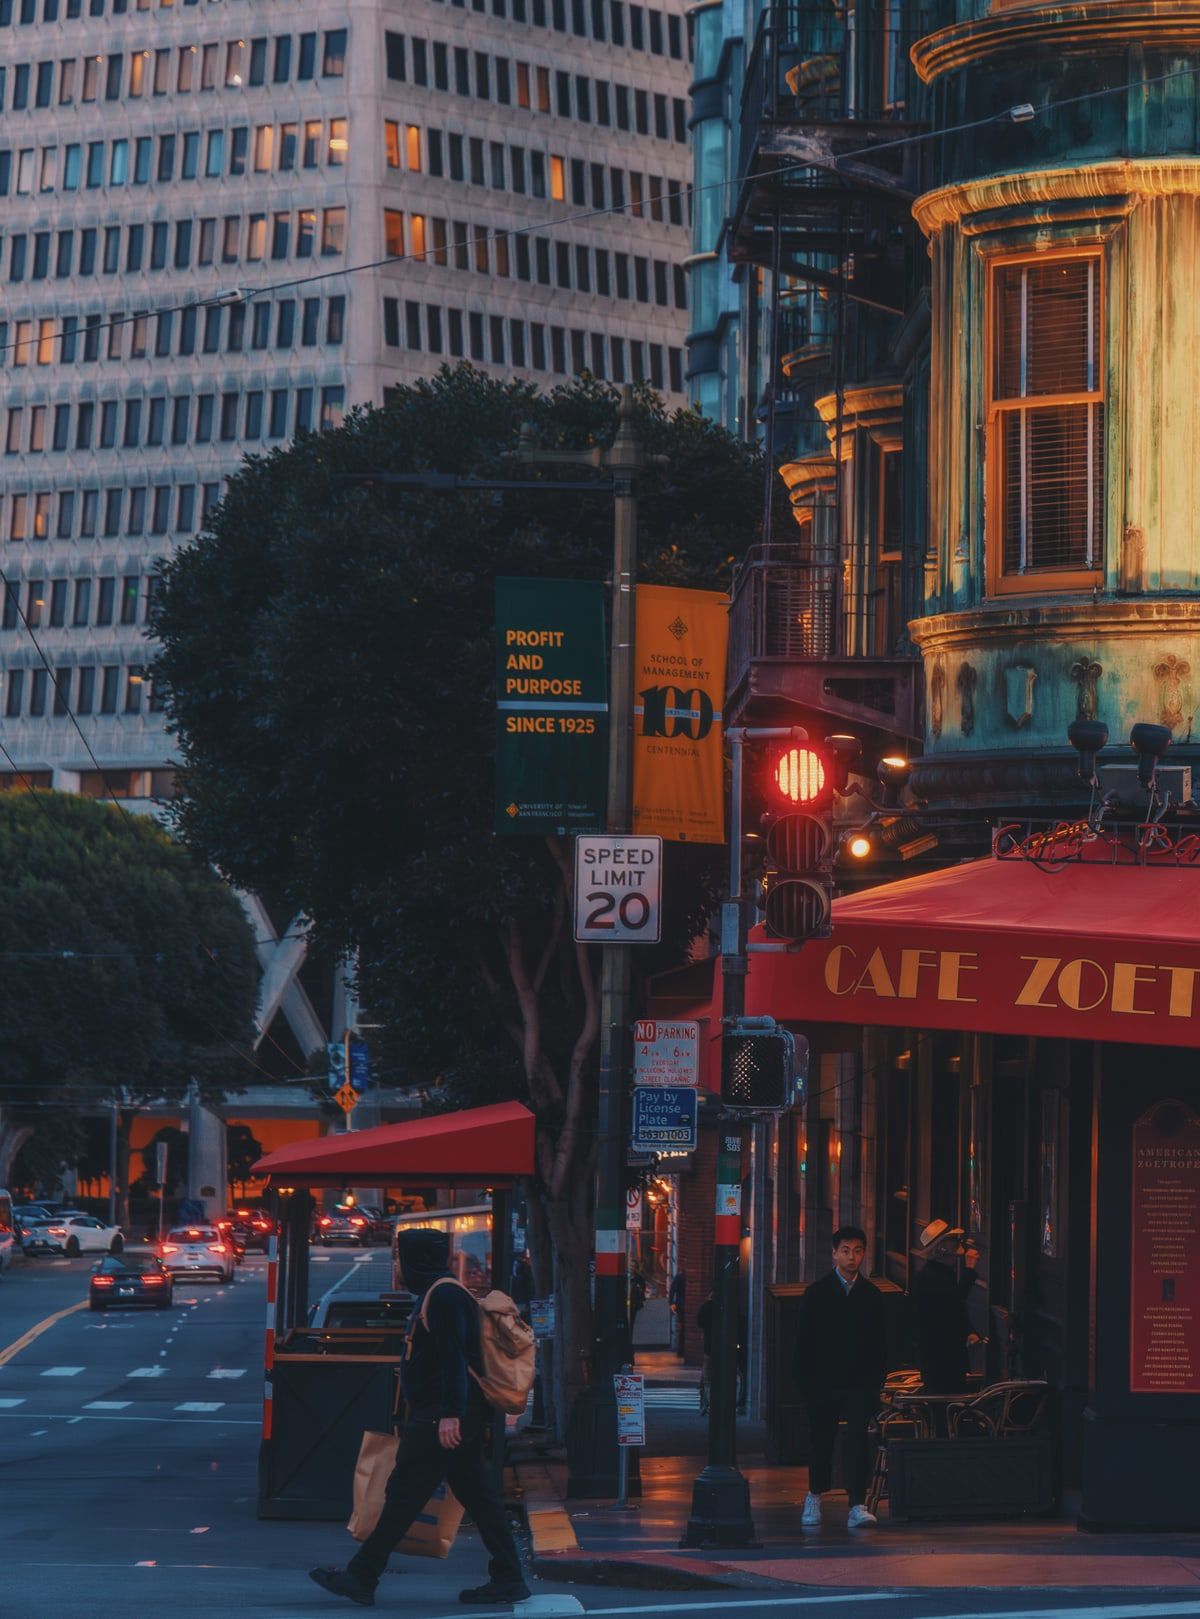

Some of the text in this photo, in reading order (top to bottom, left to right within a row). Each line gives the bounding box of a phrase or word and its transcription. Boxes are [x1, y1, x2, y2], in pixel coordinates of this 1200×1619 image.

[506, 630, 564, 647] PROFIT
[506, 655, 543, 671] AND
[651, 654, 704, 667] SCHOOL OF
[643, 666, 711, 680] MANAGEMENT
[506, 679, 582, 695] PURPOSE
[637, 685, 714, 740] 100
[506, 717, 595, 735] SINCE 1925
[647, 745, 701, 757] CENTENNIAL
[584, 848, 654, 865] SPEED
[591, 870, 646, 886] LIMIT
[584, 892, 650, 930] 20
[824, 944, 978, 1002] CAFE
[636, 1023, 695, 1040] NO PARKING
[641, 1045, 648, 1056] 4
[674, 1046, 680, 1057] 6
[640, 1090, 678, 1104] Pay by
[640, 1103, 681, 1113] License
[640, 1114, 668, 1125] Plate
[1137, 1148, 1200, 1157] AMERICAN
[1137, 1160, 1200, 1169] ZOETROPE
